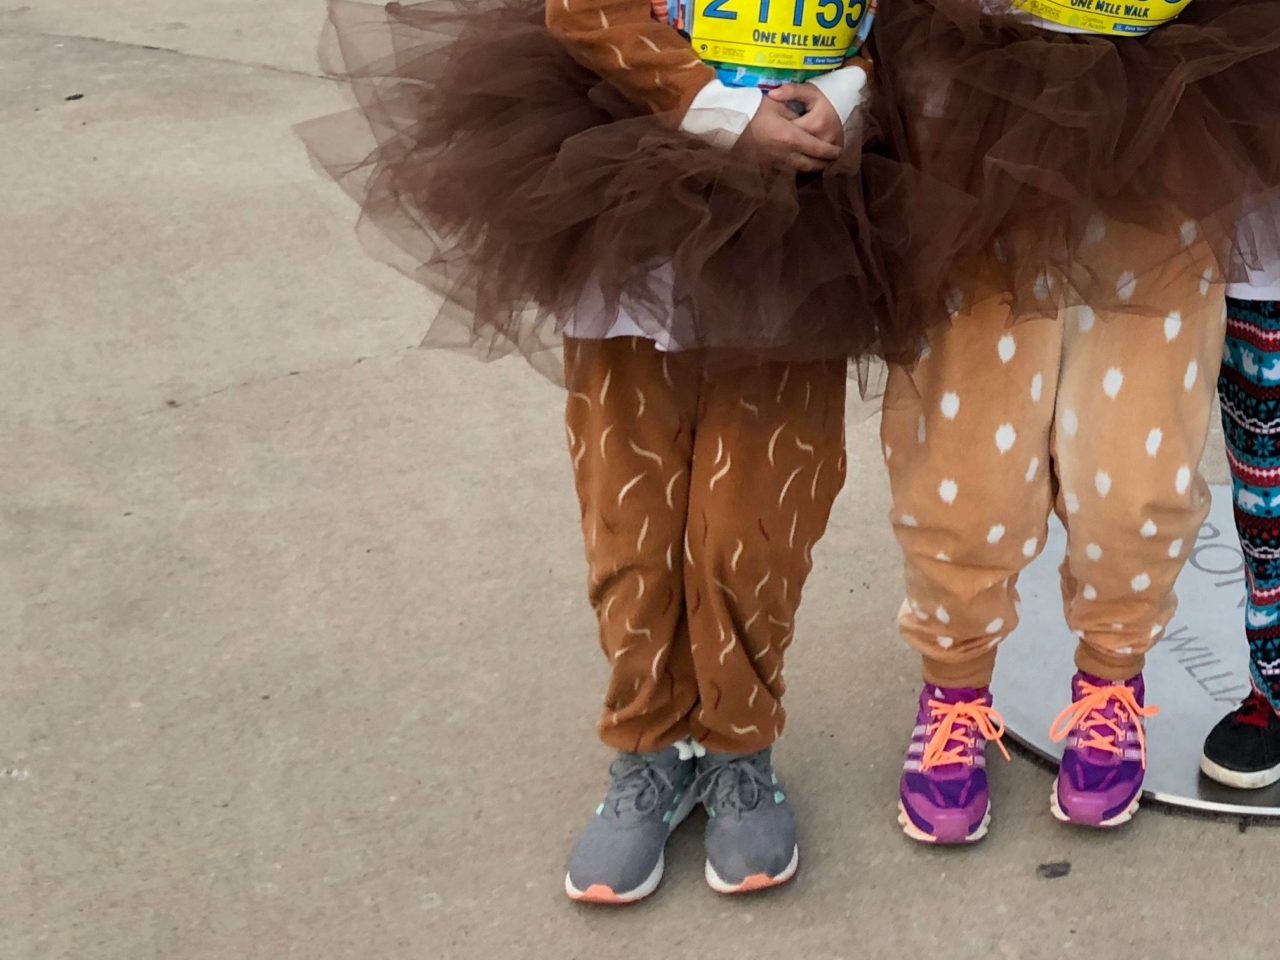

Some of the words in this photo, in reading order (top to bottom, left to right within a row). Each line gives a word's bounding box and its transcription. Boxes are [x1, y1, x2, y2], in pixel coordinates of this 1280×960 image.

[1095, 0, 1122, 15] MILE
[1124, 5, 1151, 18] WALK
[752, 29, 777, 44] ONE
[780, 32, 809, 47] MILE
[812, 34, 837, 48] WALK
